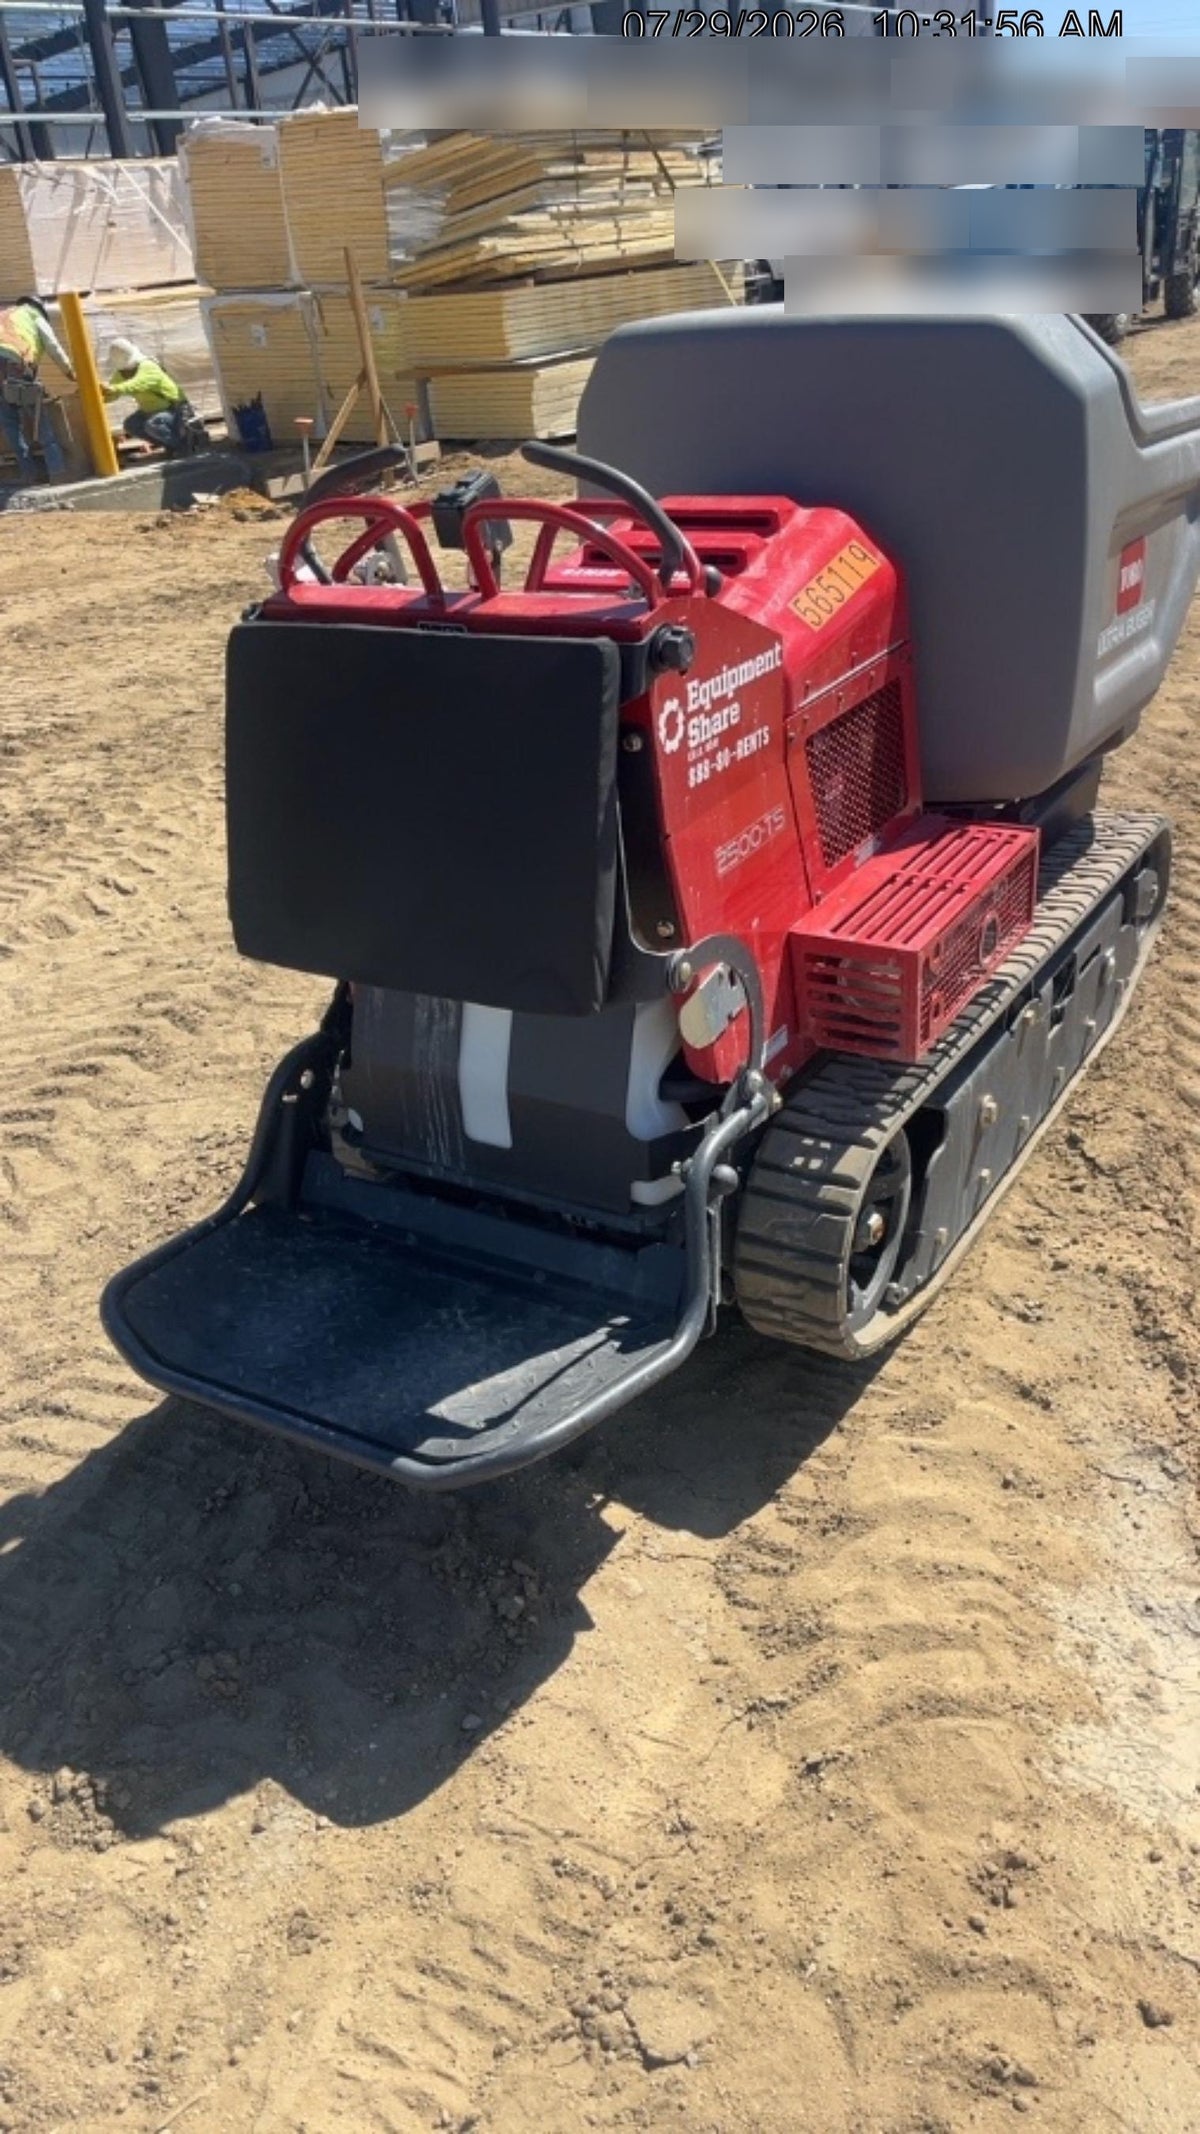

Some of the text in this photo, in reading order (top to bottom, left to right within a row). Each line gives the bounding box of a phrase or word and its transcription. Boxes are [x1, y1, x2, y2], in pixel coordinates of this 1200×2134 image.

[793, 544, 877, 626] 565119
[686, 641, 782, 713] Equipment
[687, 702, 740, 748] Share
